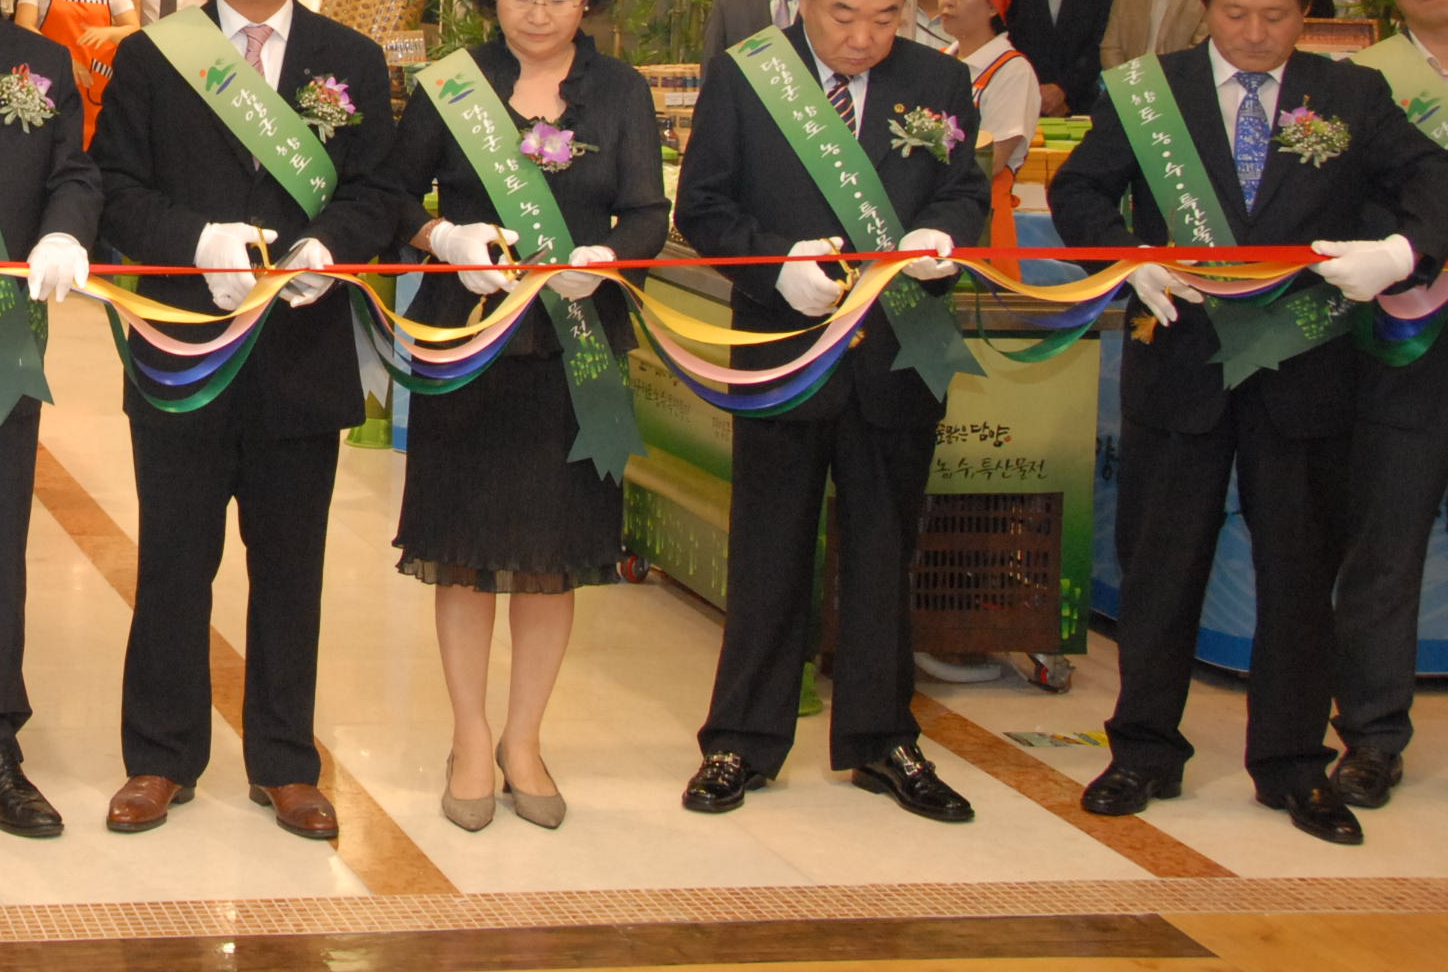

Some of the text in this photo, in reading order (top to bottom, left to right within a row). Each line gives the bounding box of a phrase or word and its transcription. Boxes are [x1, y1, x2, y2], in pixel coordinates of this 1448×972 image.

[232, 88, 277, 136] 담양군
[276, 136, 312, 175] 향토
[760, 56, 801, 102] 담양군
[792, 105, 827, 140] 향토
[1131, 91, 1160, 126] 향토
[462, 104, 502, 152] 담양군
[494, 158, 528, 195] 향토
[970, 421, 1010, 447] 담양
